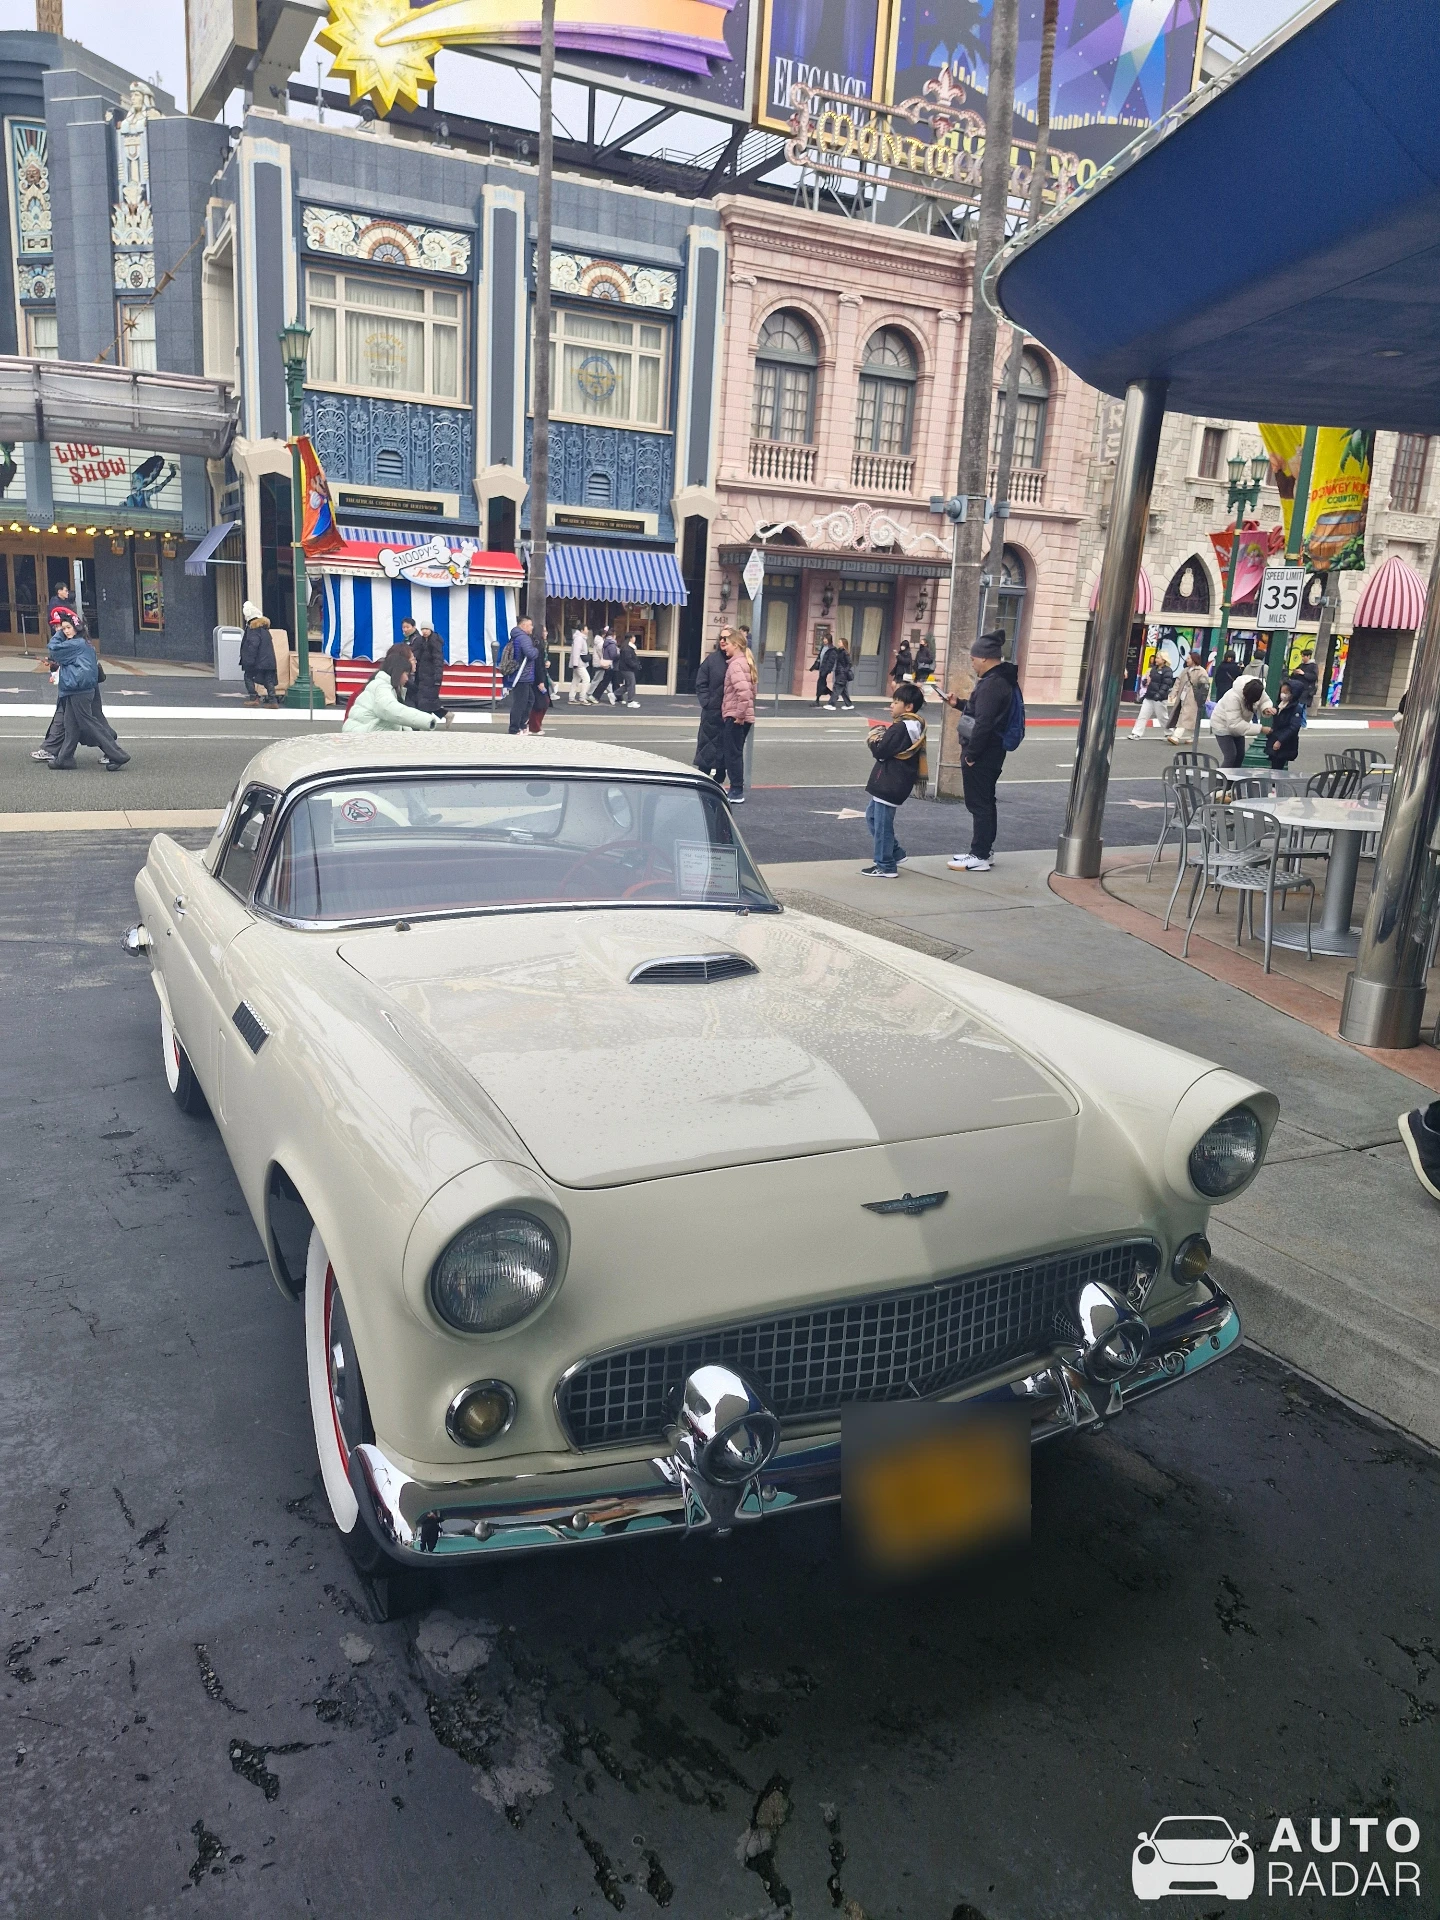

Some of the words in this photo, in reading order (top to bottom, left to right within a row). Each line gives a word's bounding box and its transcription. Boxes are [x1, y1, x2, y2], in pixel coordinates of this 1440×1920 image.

[54, 442, 101, 464] LIVE
[69, 457, 126, 485] SHOW
[392, 544, 440, 567] SNOOPY'S
[412, 566, 450, 580] Treats
[1266, 571, 1285, 580] SPEED
[1286, 572, 1303, 580] LIMIT
[1264, 585, 1298, 610] 35
[1268, 613, 1287, 623] MILES
